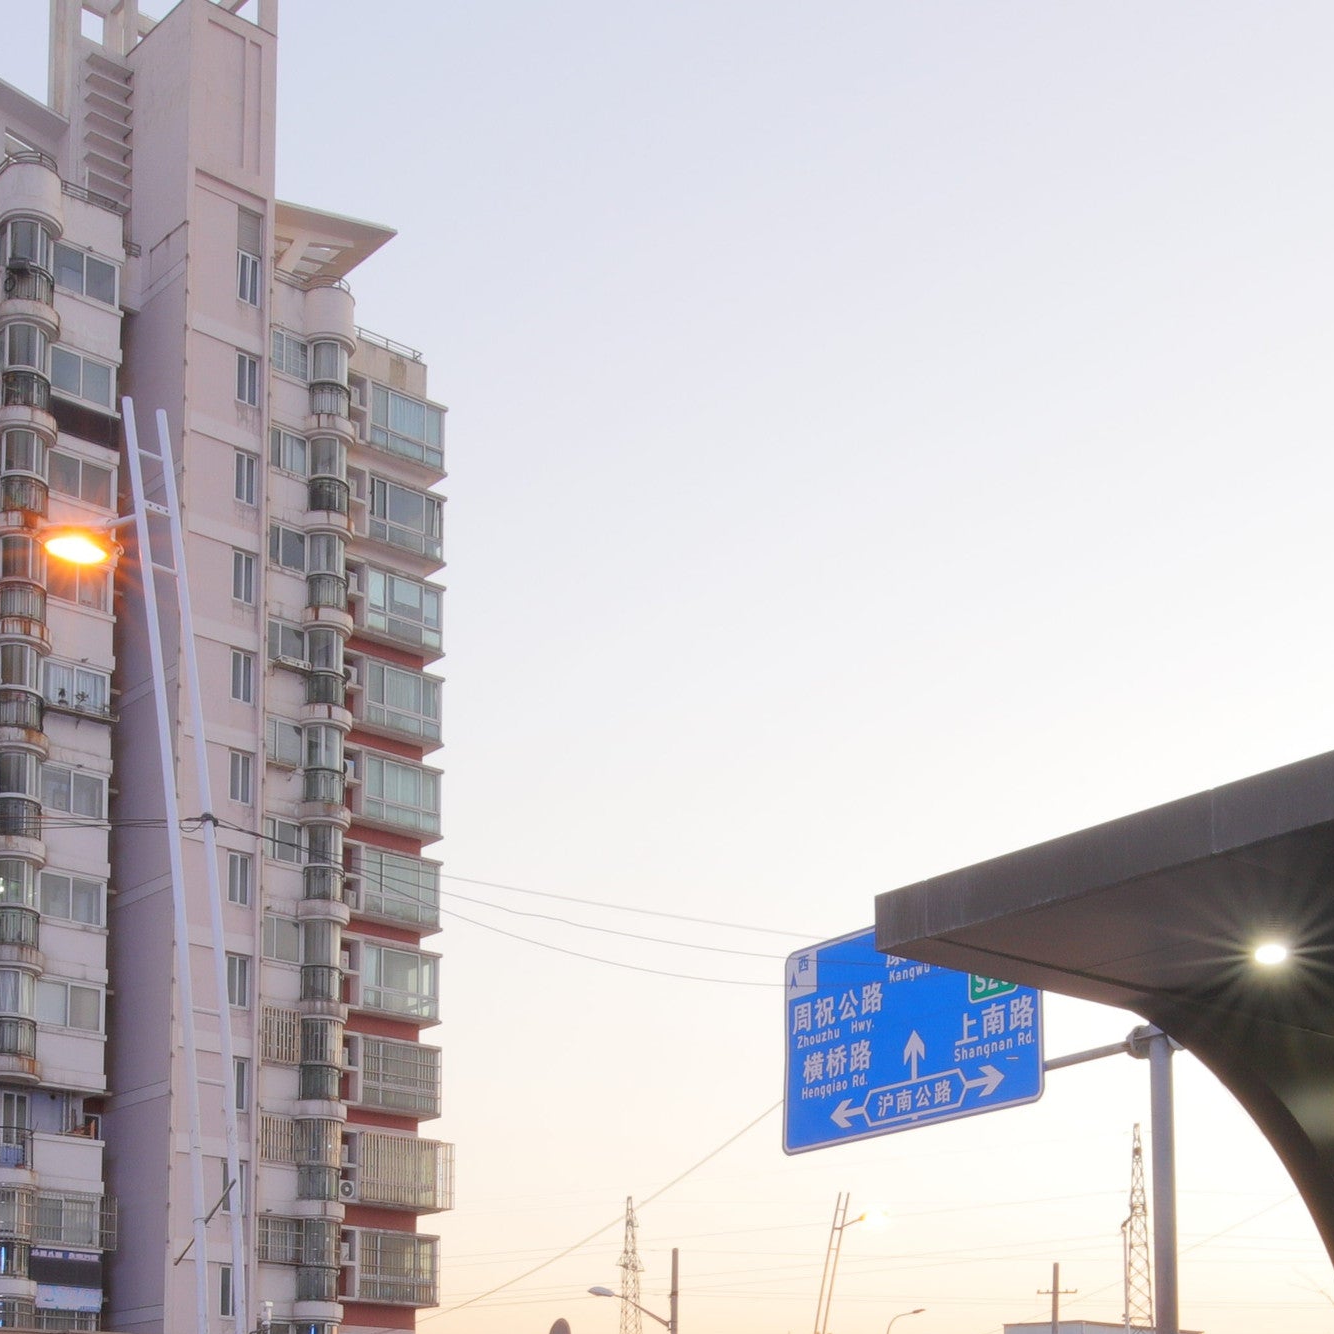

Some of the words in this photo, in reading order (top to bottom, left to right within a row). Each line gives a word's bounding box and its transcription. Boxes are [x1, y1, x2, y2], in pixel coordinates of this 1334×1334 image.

[798, 954, 809, 974] 西
[792, 981, 884, 1035] 周祝公路
[955, 995, 1035, 1046] 上南路
[797, 1028, 840, 1049] Zhouzhu
[851, 1019, 875, 1034] Hwy.
[954, 1037, 1013, 1062] Shangnan
[1018, 1030, 1035, 1047] Rd.
[802, 1039, 872, 1085] 横桥路
[802, 1080, 848, 1100] Hengqiao
[852, 1073, 868, 1087] Rd.
[877, 1079, 952, 1117] 沪南公路
